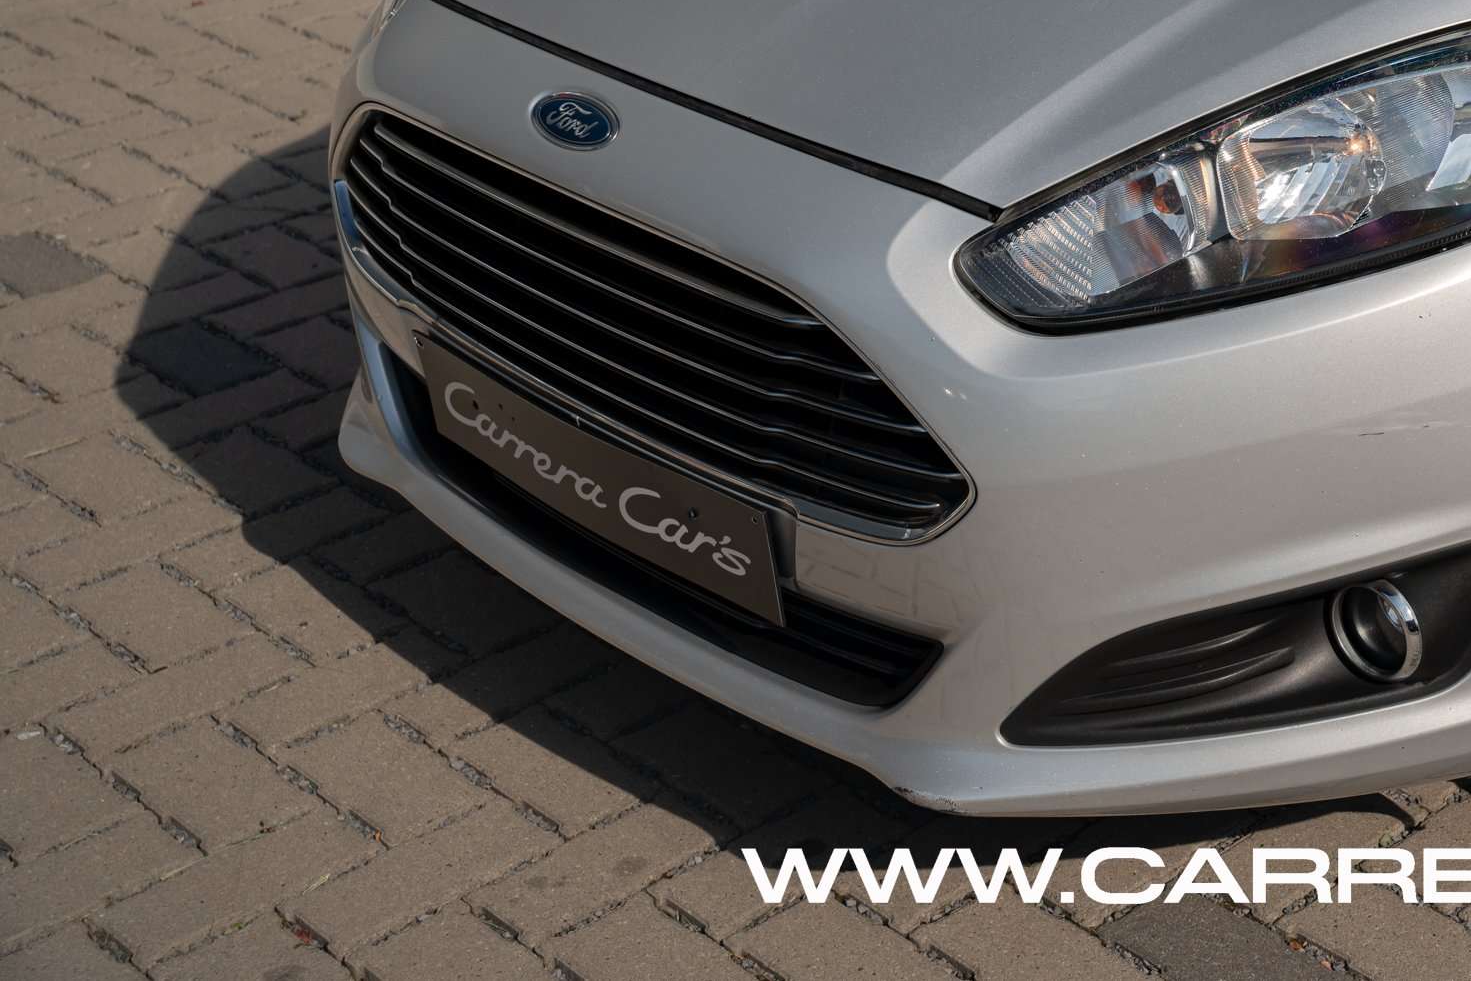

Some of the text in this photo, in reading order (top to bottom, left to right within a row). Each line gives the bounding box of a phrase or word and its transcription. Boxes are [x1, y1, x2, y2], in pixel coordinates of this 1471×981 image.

[545, 101, 599, 139] Ford
[444, 380, 752, 576] Carrera Car's
